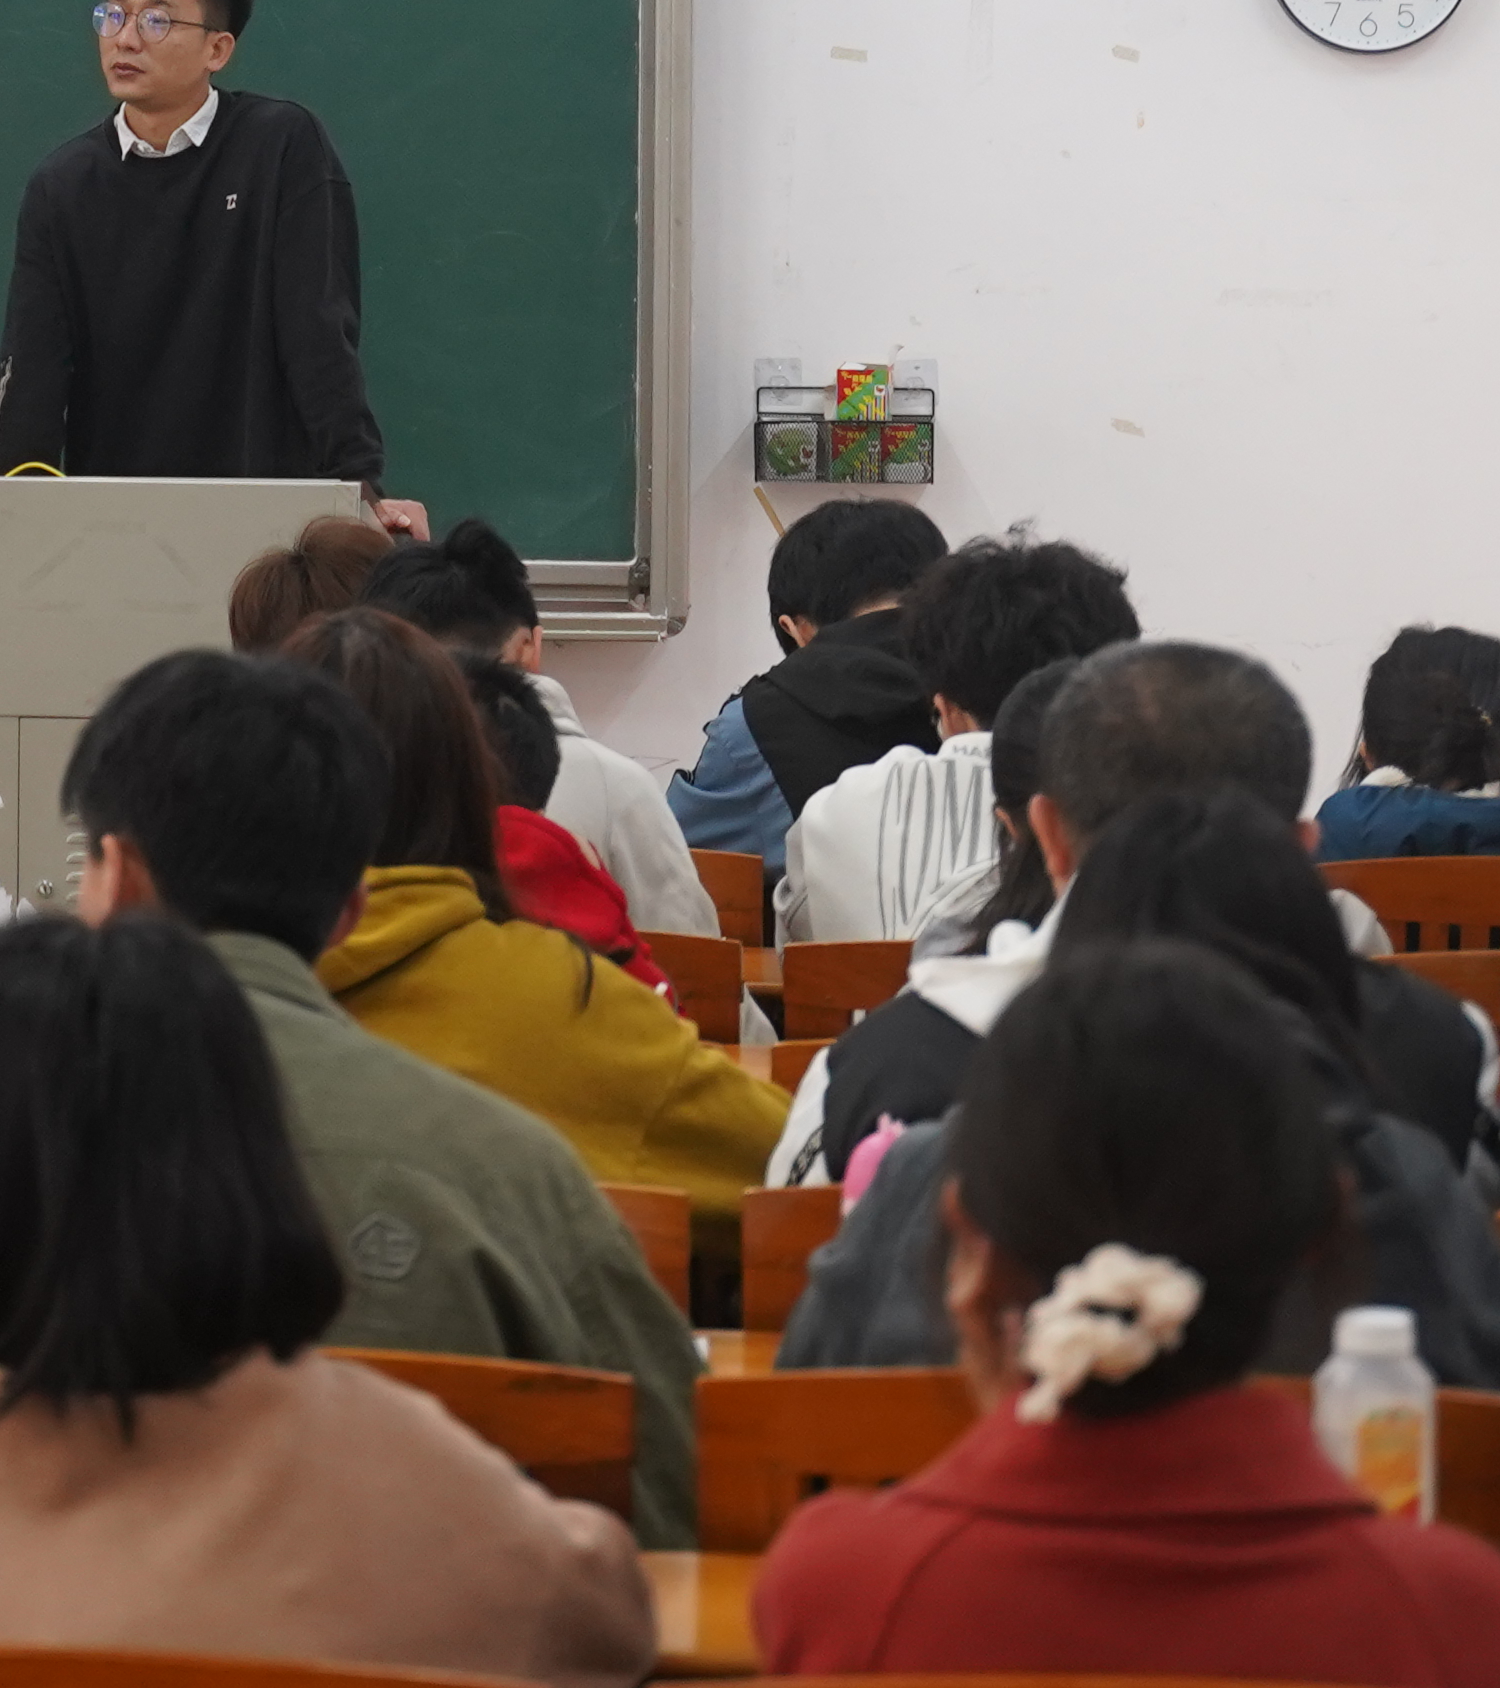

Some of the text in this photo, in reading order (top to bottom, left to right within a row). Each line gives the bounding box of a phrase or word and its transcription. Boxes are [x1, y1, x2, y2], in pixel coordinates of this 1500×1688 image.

[1324, 1, 1342, 27] 7
[1359, 11, 1378, 37] 6
[1397, 3, 1415, 28] 5
